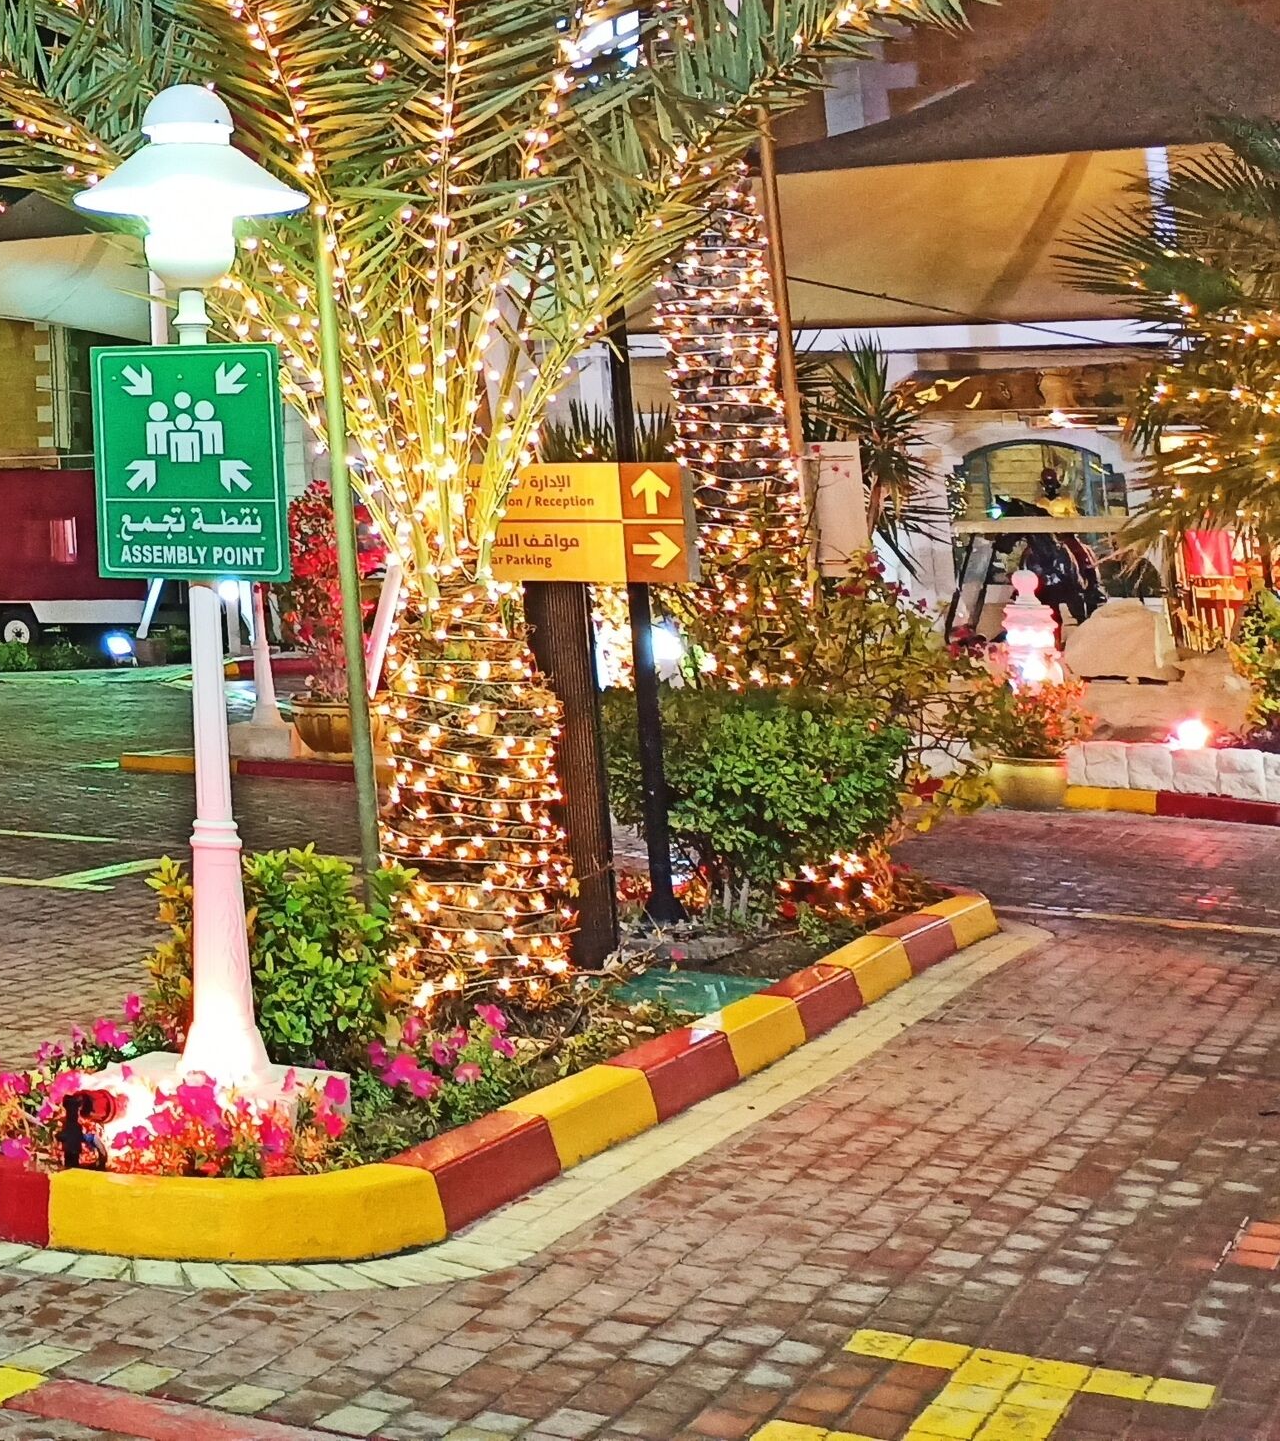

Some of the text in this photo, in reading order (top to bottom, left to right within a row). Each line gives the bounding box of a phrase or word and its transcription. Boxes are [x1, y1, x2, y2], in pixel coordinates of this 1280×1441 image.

[529, 475, 571, 492] الإدارة
[534, 495, 595, 509] Reception
[121, 507, 262, 542] نقطة تجمع
[523, 533, 580, 552] مواقف
[121, 544, 265, 566] ASSEMBLY POINT
[506, 554, 553, 568] Parking
